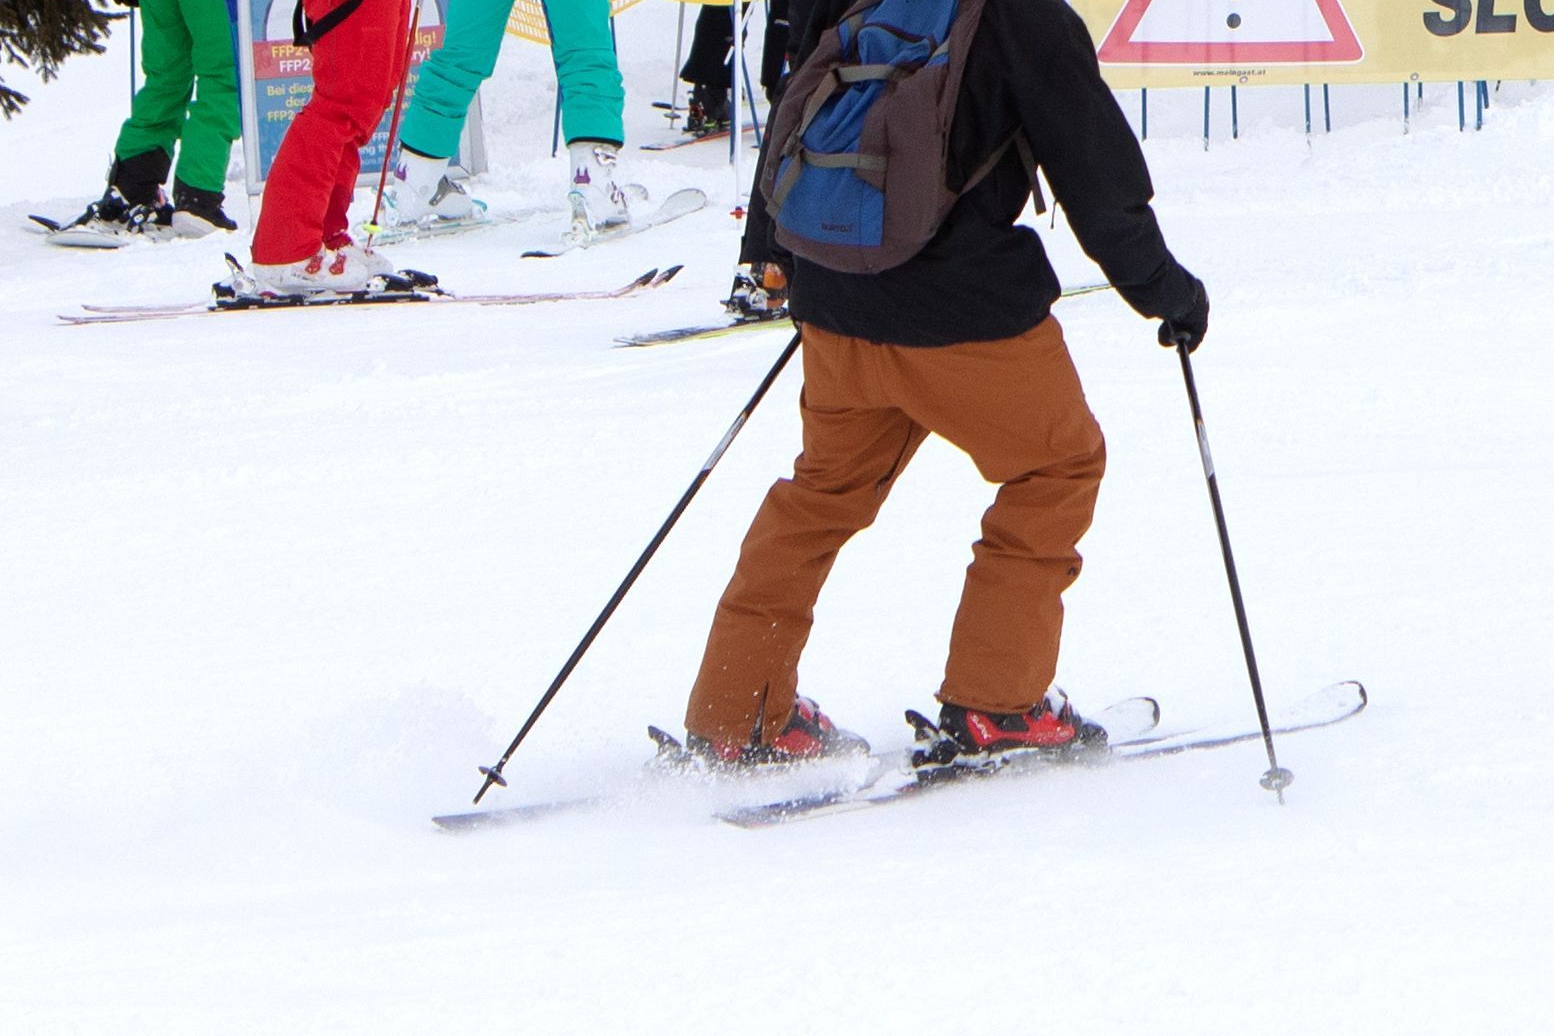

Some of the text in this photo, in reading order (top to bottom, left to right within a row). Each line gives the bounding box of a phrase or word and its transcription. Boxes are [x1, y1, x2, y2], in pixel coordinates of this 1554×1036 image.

[272, 44, 310, 58] FFP2-
[280, 48, 430, 73] FFP2 ry!
[267, 83, 313, 96] Bei dies
[267, 109, 296, 122] FFP2
[372, 132, 390, 141] FFP
